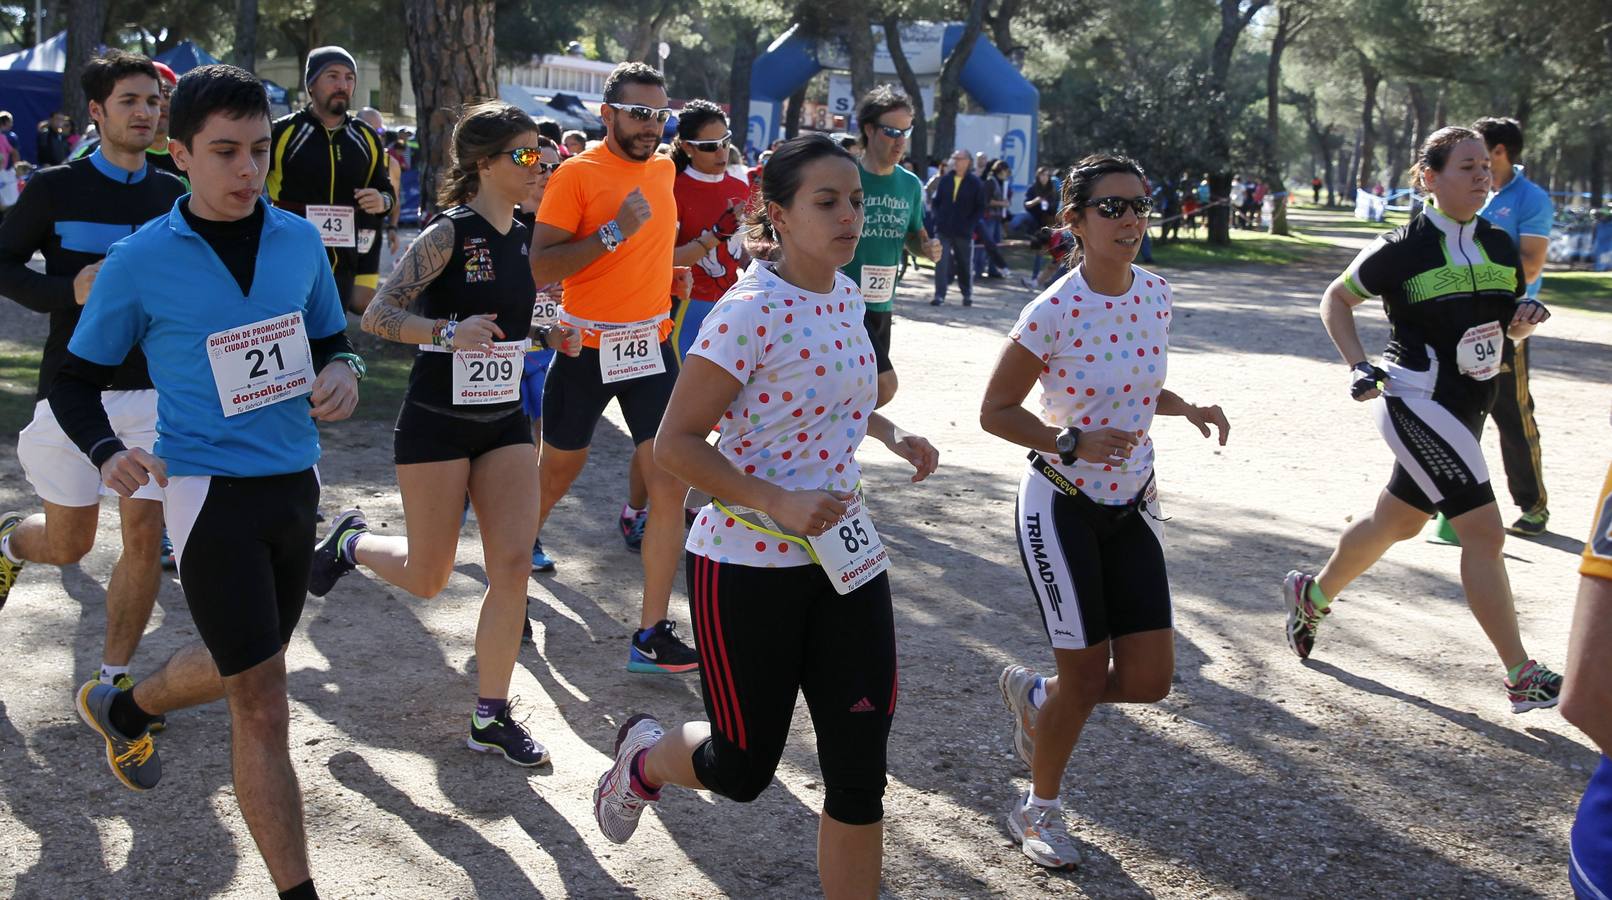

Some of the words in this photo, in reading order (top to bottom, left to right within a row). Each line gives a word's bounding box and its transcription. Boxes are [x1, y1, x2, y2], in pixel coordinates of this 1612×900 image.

[322, 218, 342, 232] 43
[1433, 266, 1512, 290] Spiuk
[224, 340, 249, 353] CIUDAD
[251, 338, 259, 346] DE
[260, 328, 296, 343] VALLADOLID
[242, 330, 251, 338] DE
[245, 343, 285, 379] 21
[612, 340, 648, 361] 148
[1474, 339, 1496, 361] 94
[469, 360, 513, 382] 209
[607, 363, 656, 377] dorsalia.com
[232, 377, 307, 404] dorsalia.com
[461, 389, 514, 397] dorsalia.com
[839, 518, 869, 553] 85
[841, 550, 886, 583] dorsalia.com
